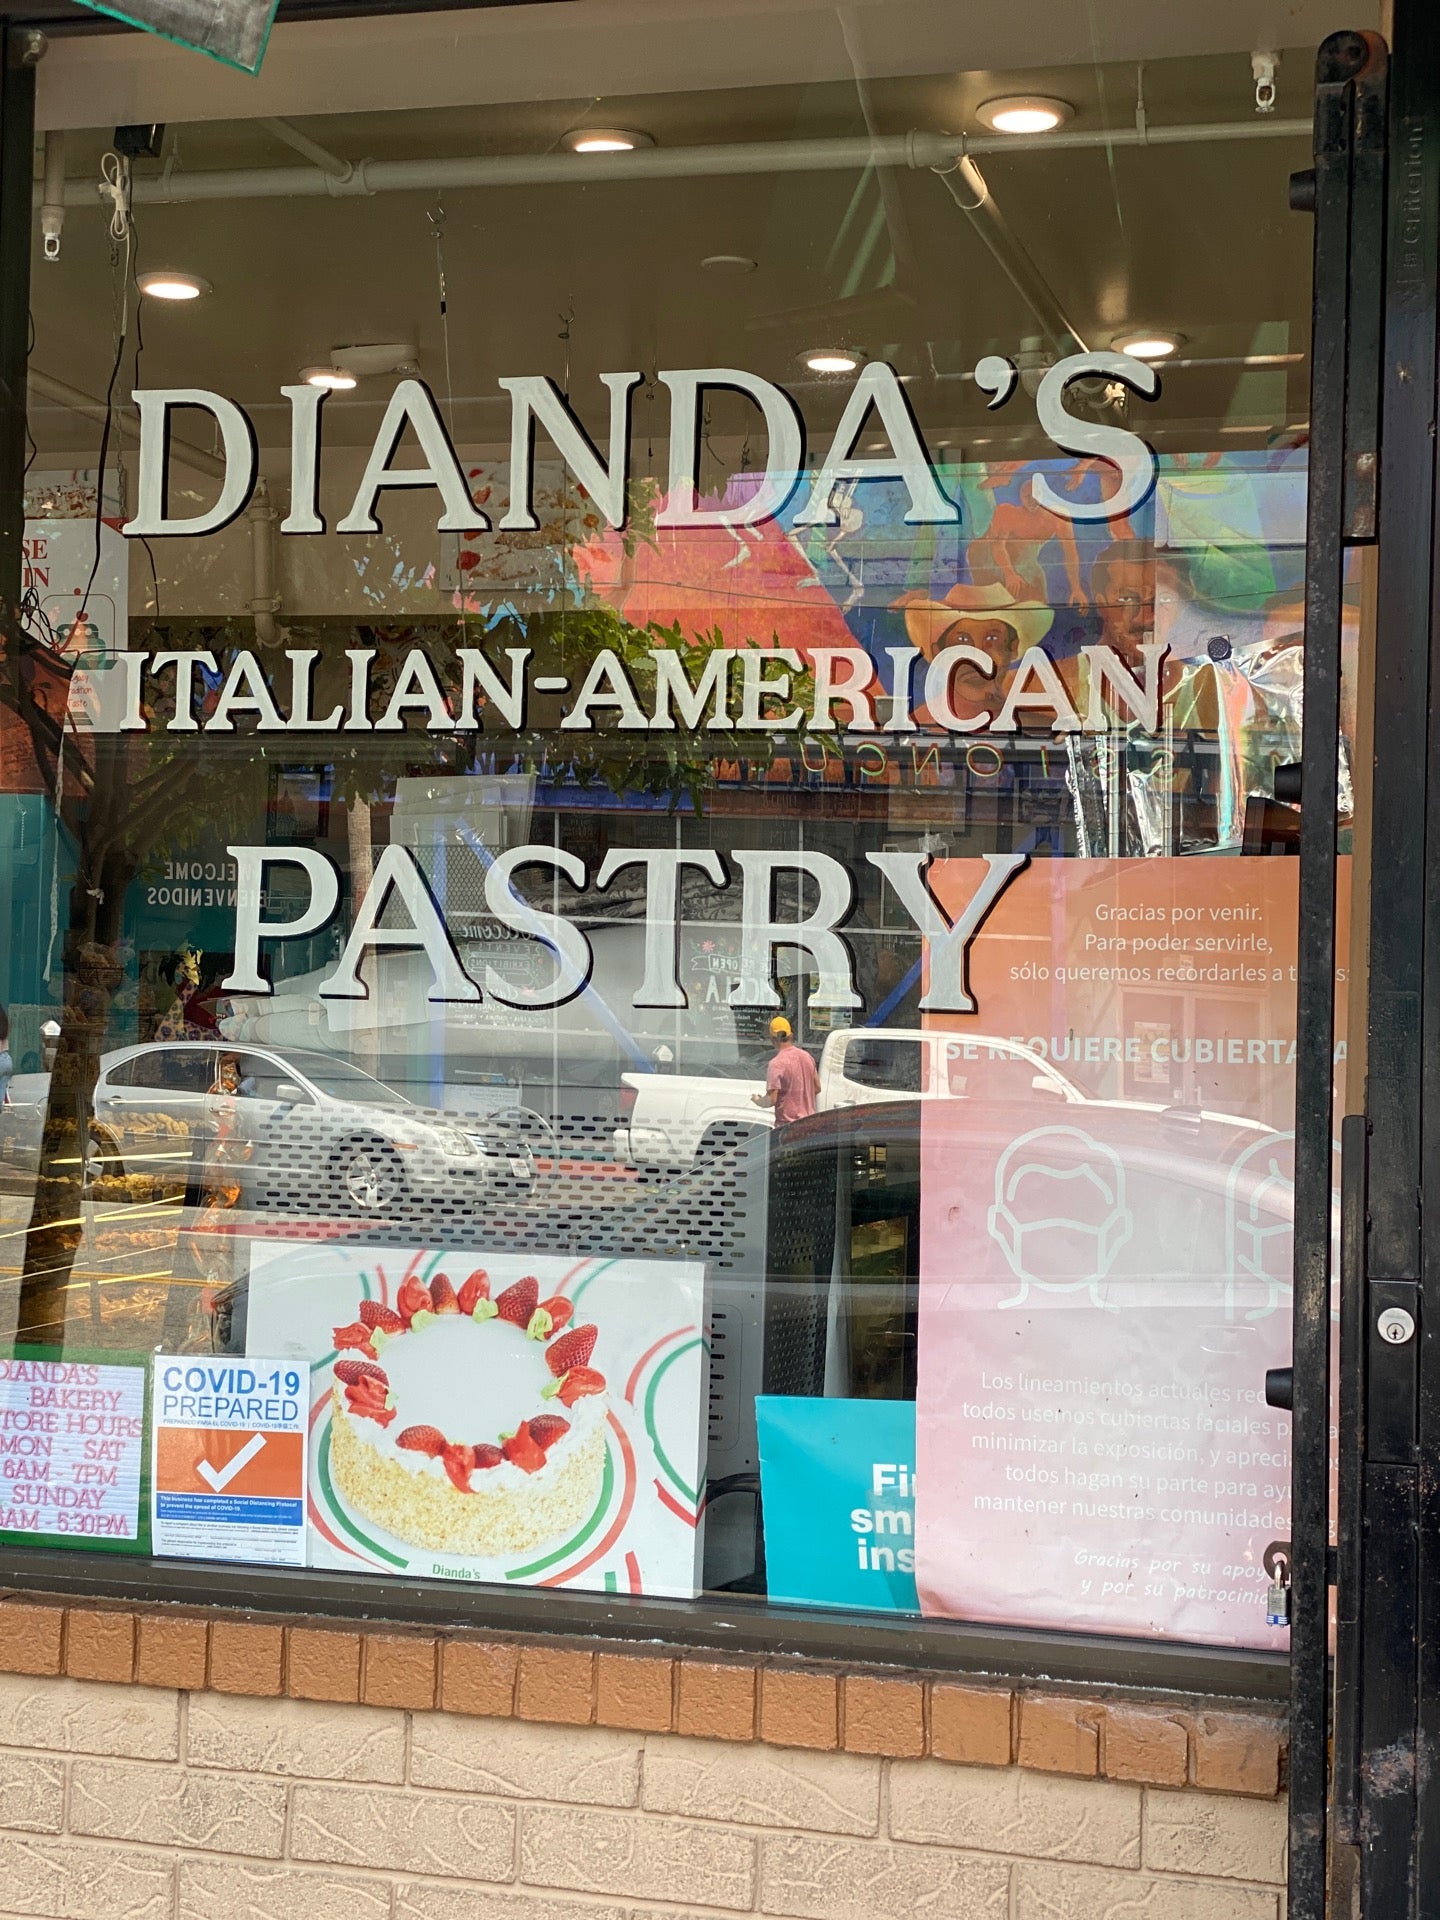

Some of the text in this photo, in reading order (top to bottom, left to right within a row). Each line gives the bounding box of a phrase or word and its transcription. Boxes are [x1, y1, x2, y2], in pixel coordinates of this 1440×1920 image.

[122, 353, 1161, 537] DIANDA'S
[120, 643, 1172, 735] ITALIAN-AMERICAN
[1095, 903, 1264, 927] Gracias por venir.
[222, 845, 1031, 1014] PASTRY
[1085, 933, 1273, 957] Para poder servirle,
[1010, 962, 1050, 981] sólo
[1055, 968, 1151, 987] queremos
[1157, 963, 1267, 982] recordarles
[1272, 968, 1283, 982] a
[946, 1039, 979, 1060] SE
[988, 1036, 1142, 1063] REQUIERE
[163, 1366, 300, 1396] COVID-19
[980, 1371, 1013, 1392] Los
[1018, 1372, 1144, 1398] lineamientos
[1149, 1379, 1231, 1402] actuales
[29, 1386, 122, 1411] BAKERY
[163, 1395, 298, 1421] PREPARED
[0, 1409, 143, 1437] TORE HOURS
[962, 1401, 1015, 1421] todos
[1021, 1407, 1095, 1425] usemos
[1100, 1408, 1190, 1432] cubiertas
[1196, 1413, 1272, 1435] faciales
[0, 1434, 53, 1457] MON
[83, 1440, 127, 1462] SAT
[971, 1432, 1066, 1454] minimizar
[1072, 1435, 1088, 1455] la
[1094, 1438, 1205, 1465] exposición,
[1210, 1447, 1220, 1466] y
[3, 1459, 52, 1482] 6AM
[72, 1464, 119, 1487] 7PM
[872, 1463, 917, 1498] Fi
[1005, 1463, 1059, 1483] todos
[1064, 1467, 1123, 1491] hagan
[1128, 1473, 1150, 1489] su
[1157, 1475, 1208, 1494] parte
[1214, 1478, 1256, 1497] para
[11, 1484, 107, 1510] SUNDAY
[57, 1512, 130, 1536] 5:30PM
[974, 1494, 1292, 1531] mantener nuestras comunidades
[432, 1563, 480, 1580] Dianda's
[1074, 1549, 1267, 1582] Gracias por su apoy
[1081, 1578, 1090, 1594] y
[1101, 1580, 1134, 1598] por
[1143, 1582, 1163, 1597] su
